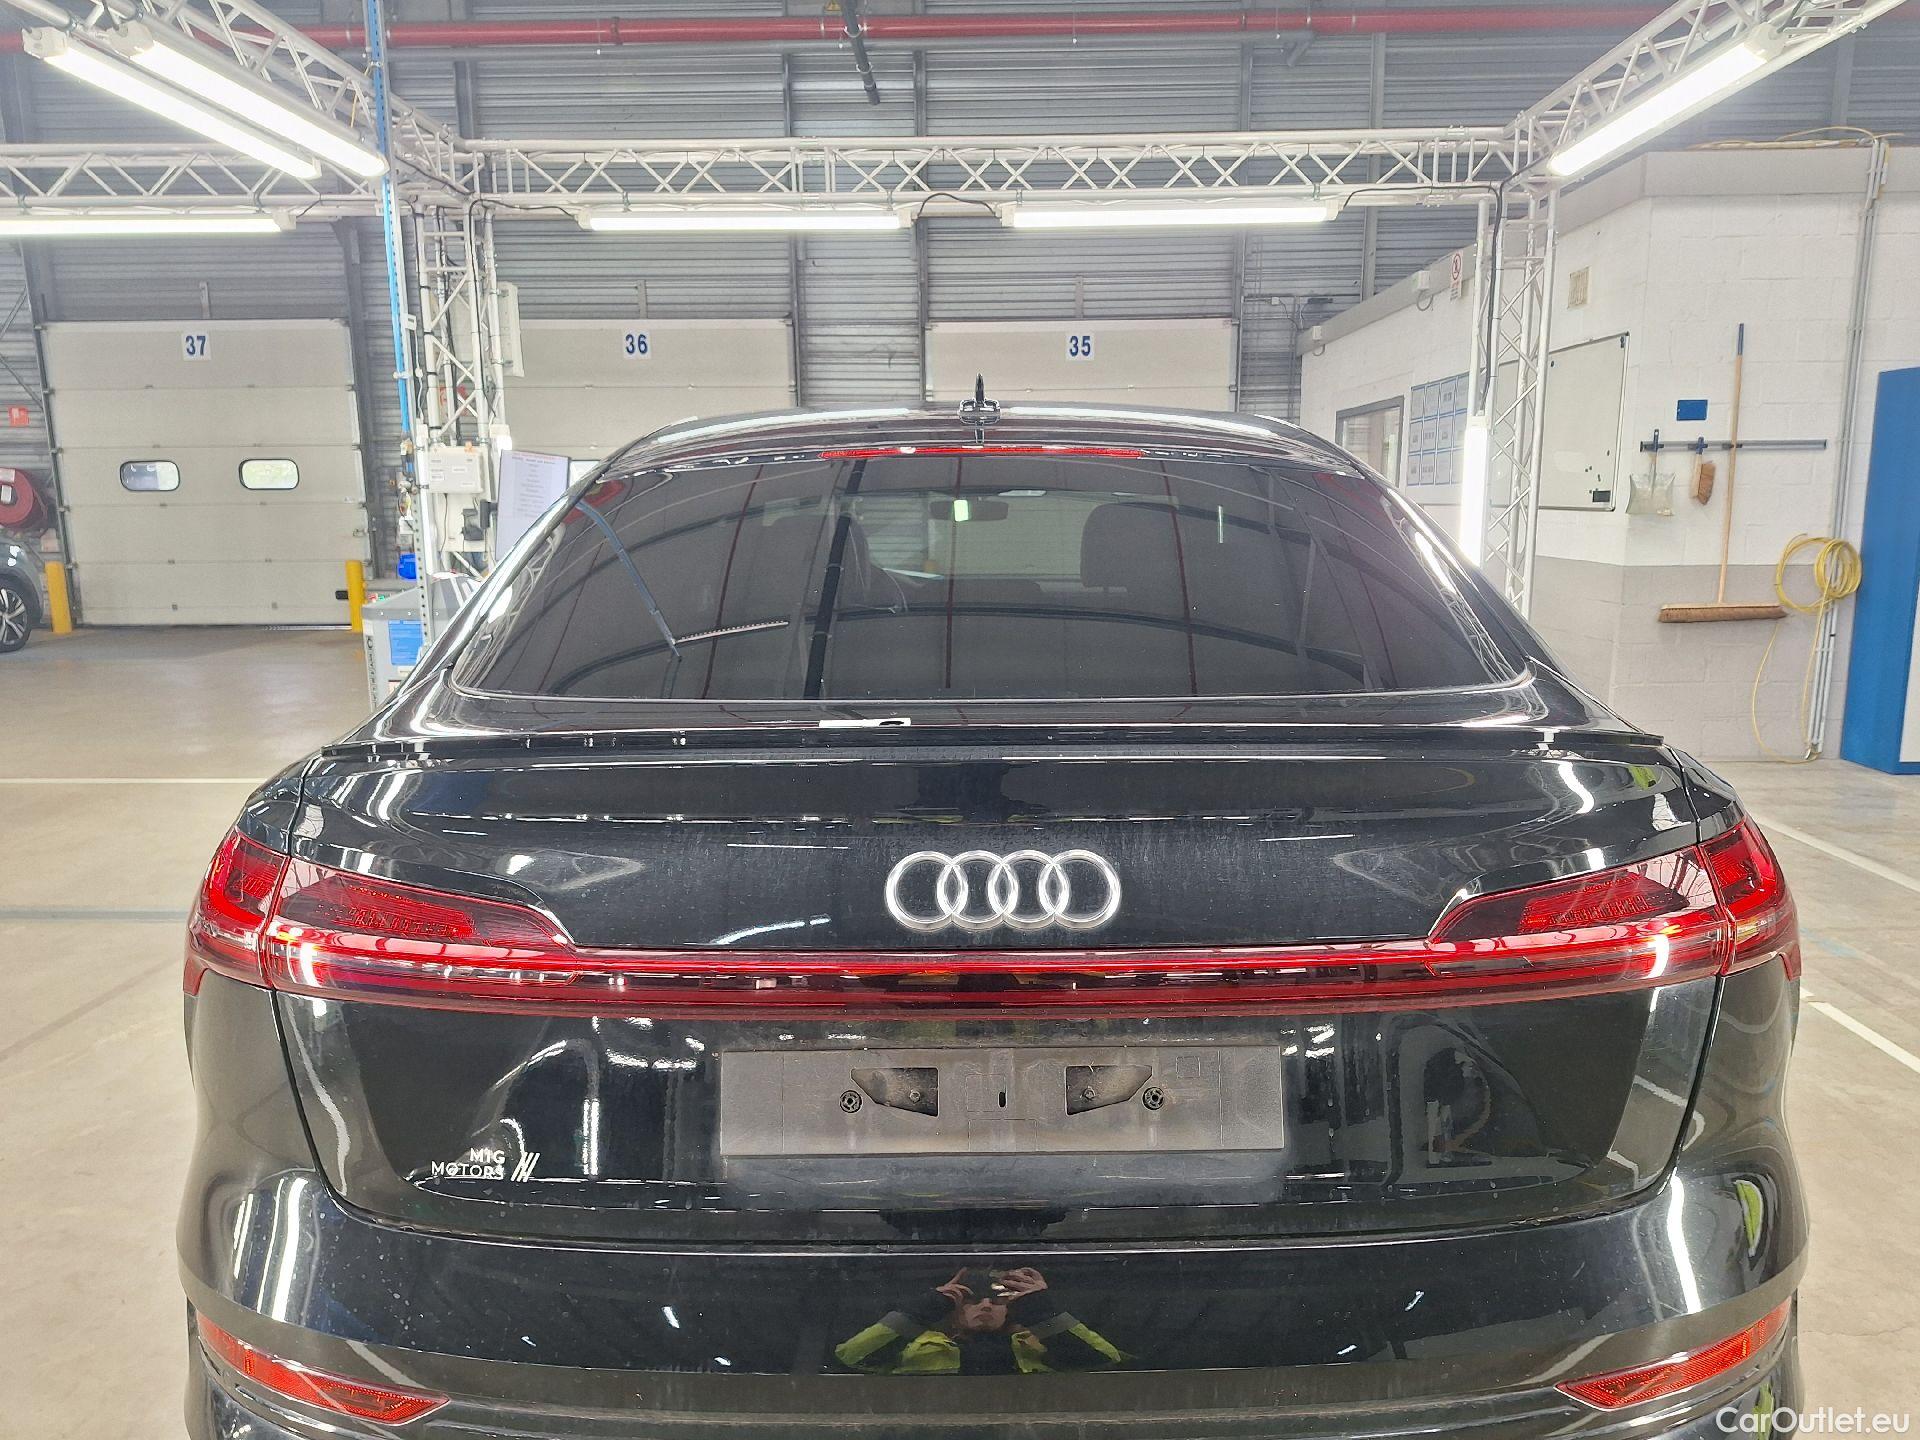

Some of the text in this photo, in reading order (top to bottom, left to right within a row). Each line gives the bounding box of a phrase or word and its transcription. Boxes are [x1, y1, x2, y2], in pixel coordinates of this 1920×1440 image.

[185, 335, 206, 356] 37
[625, 333, 648, 355] 36
[1069, 335, 1091, 357] 35
[431, 1160, 504, 1179] MOTORS
